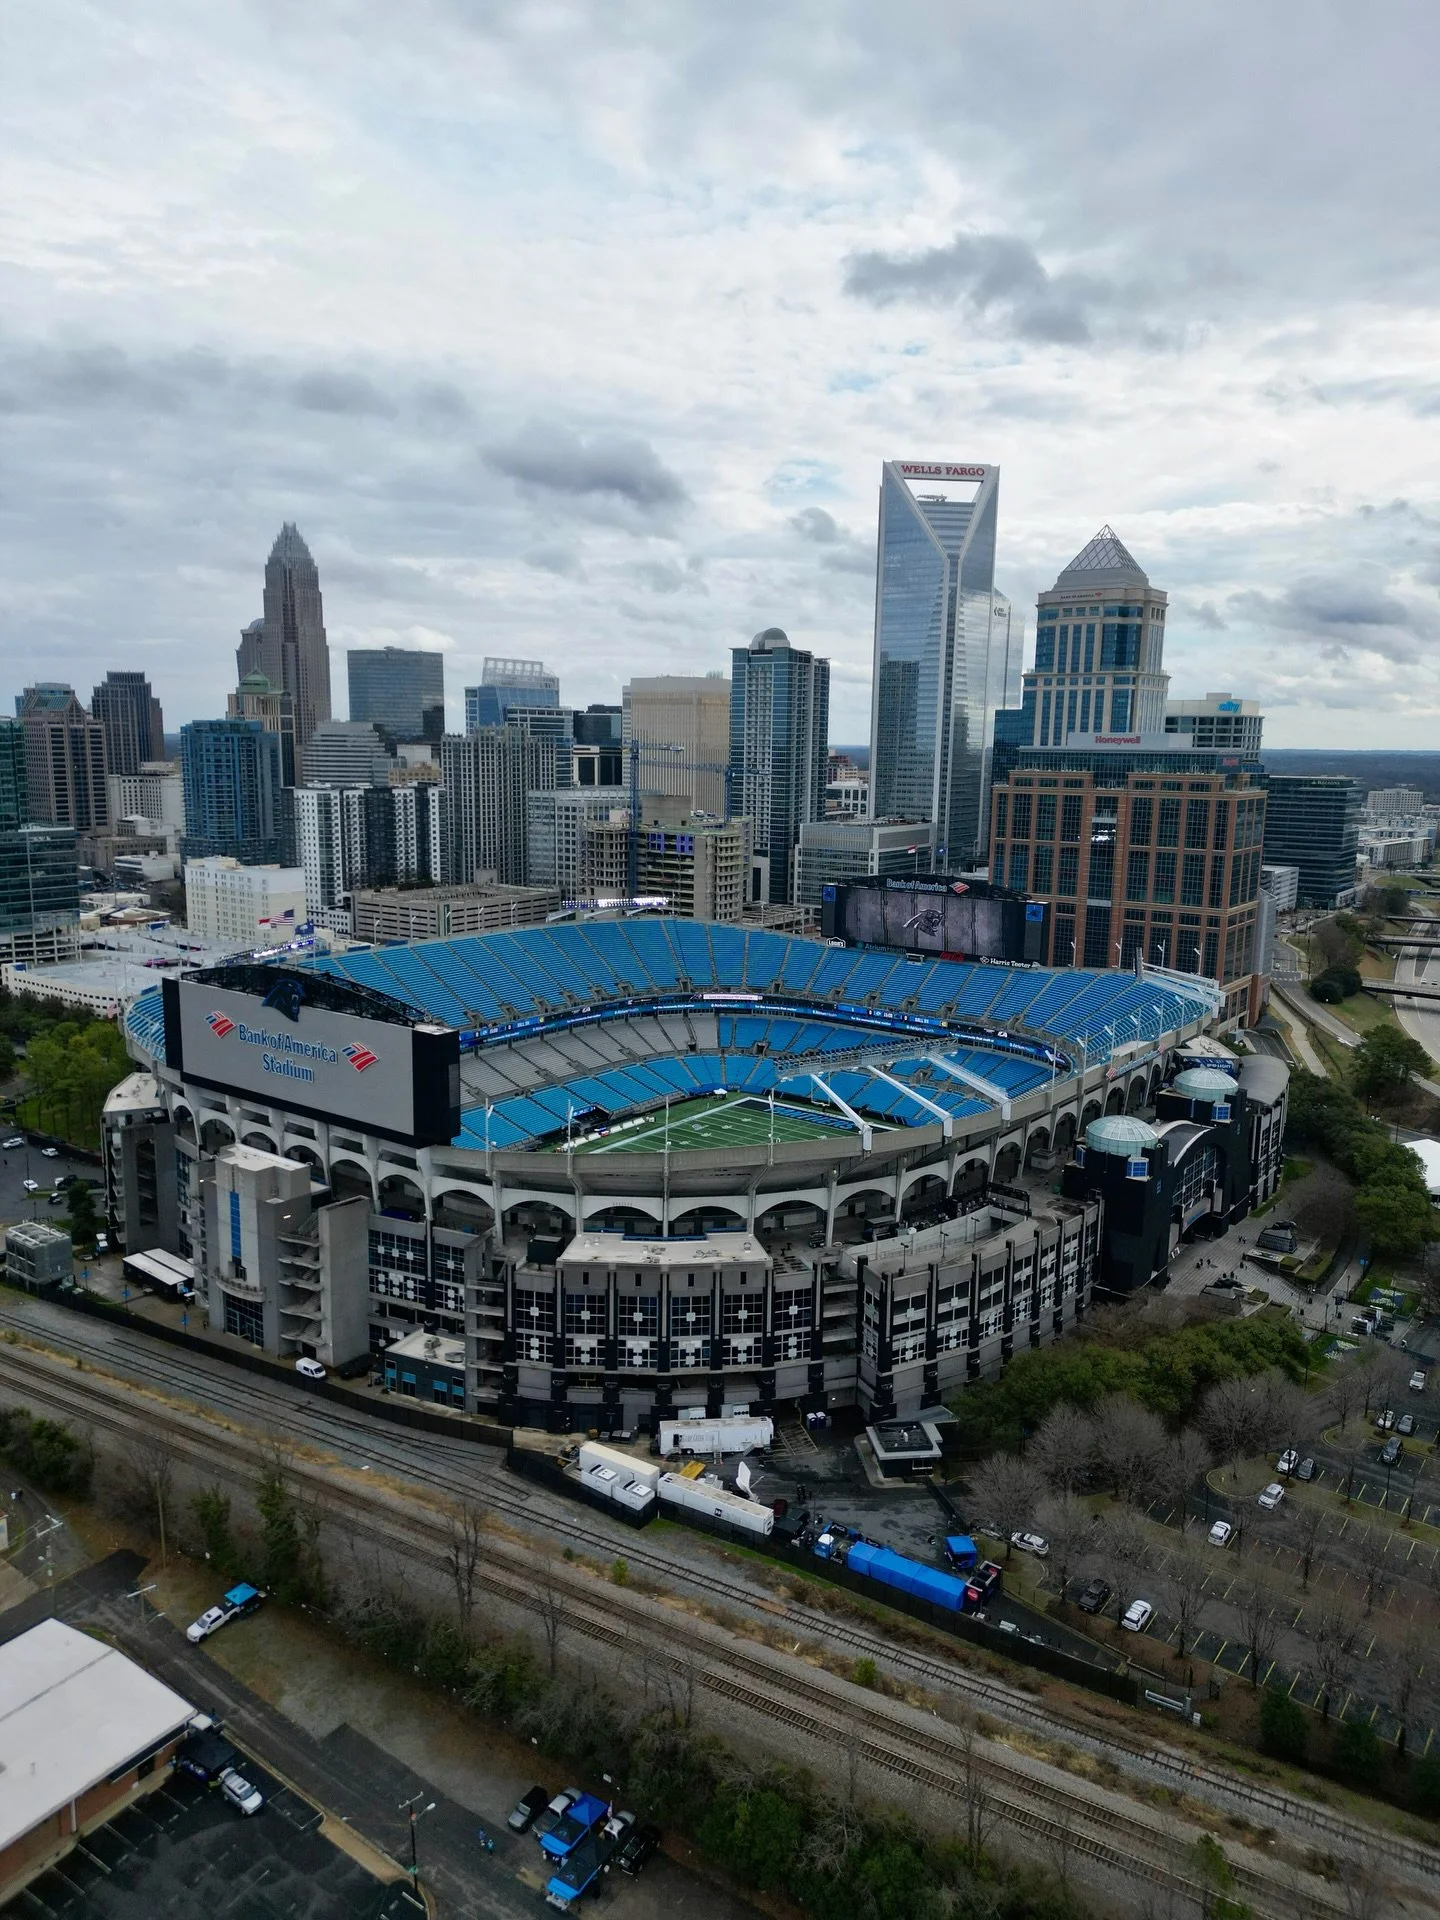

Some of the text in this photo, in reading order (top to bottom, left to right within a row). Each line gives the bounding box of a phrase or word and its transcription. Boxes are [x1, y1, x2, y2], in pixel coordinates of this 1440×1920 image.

[901, 465, 984, 476] WELLS FARGO
[1095, 736, 1141, 745] Honeywell
[886, 878, 948, 892] Bank of America
[865, 943, 887, 952] Atrium
[990, 958, 1031, 969] Harris Teeter
[239, 1023, 338, 1063] Bank of America
[262, 1052, 315, 1083] Stadium
